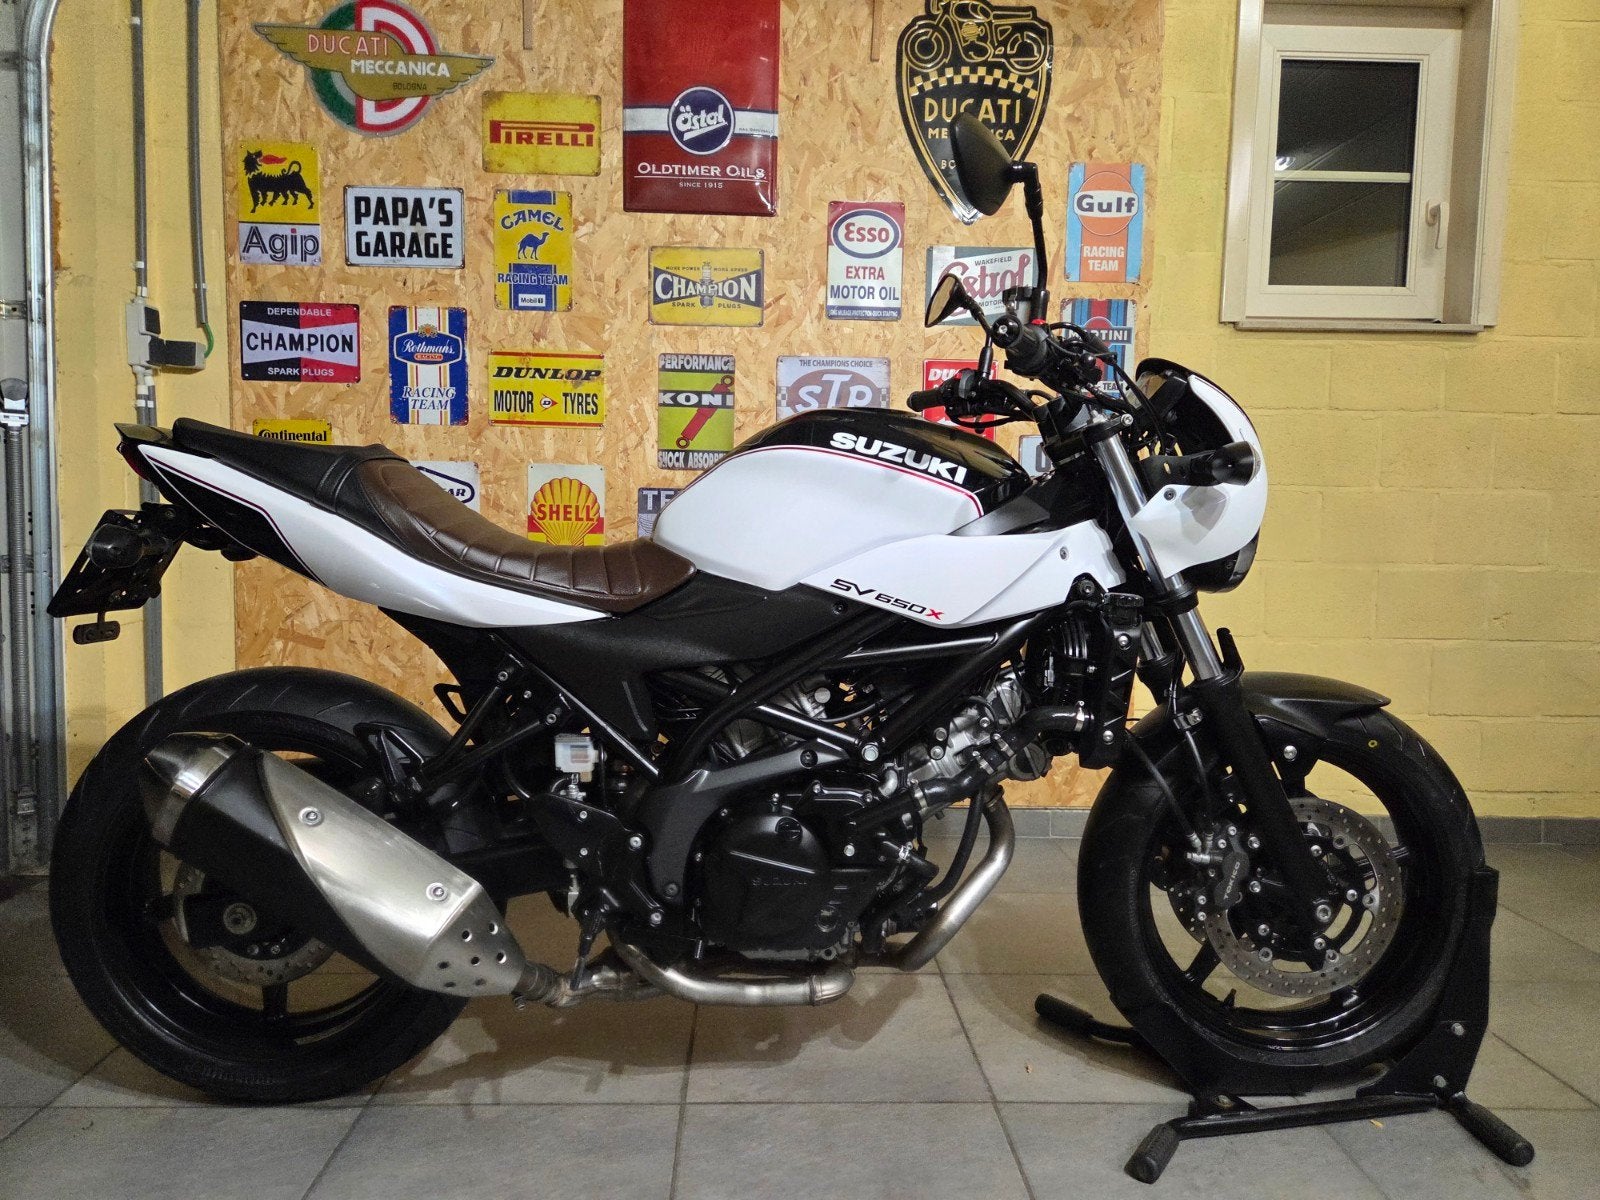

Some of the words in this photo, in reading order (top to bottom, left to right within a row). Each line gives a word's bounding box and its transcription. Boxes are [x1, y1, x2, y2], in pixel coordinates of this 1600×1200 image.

[308, 34, 389, 55] DUCATI
[351, 60, 450, 77] MECCANICA
[393, 82, 427, 91] BOLOGNA
[489, 119, 596, 147] PIRELLI
[637, 162, 721, 177] OLDTIMER
[726, 165, 766, 180] OILS
[354, 196, 453, 227] PAPA'S
[1076, 194, 1137, 214] Gulf
[500, 209, 564, 231] CAMEL
[242, 226, 320, 262] Agip
[355, 231, 454, 259] GARAGE
[1083, 245, 1125, 258] RACING
[975, 256, 1012, 266] WAKEFIELD
[1088, 258, 1119, 271] TEAM
[498, 273, 538, 284] RACING
[539, 274, 568, 286] TEAM
[845, 265, 885, 281] EXTRA
[655, 273, 757, 302] CHAMPION
[830, 285, 875, 299] MOTOR
[879, 286, 899, 300] OIL
[267, 307, 332, 317] DEPENDABLE
[246, 332, 354, 353] CHAMPION
[659, 354, 735, 371] PERFORMANCE
[799, 359, 811, 367] THE
[850, 360, 873, 368] CHOICE
[267, 367, 300, 376] SPARK
[302, 368, 335, 377] PLUGS
[492, 366, 602, 382] DUNLOP
[402, 386, 456, 399] RACING
[658, 392, 734, 406] KONI
[795, 373, 873, 413] STP
[411, 399, 450, 410] TEAM
[493, 389, 534, 413] MOTOR
[562, 392, 599, 416] TYRES
[658, 451, 686, 468] SHOCK
[830, 431, 968, 485] SUZUKI
[536, 503, 596, 522] SHELL
[1222, 860, 1241, 900] TOKICO
